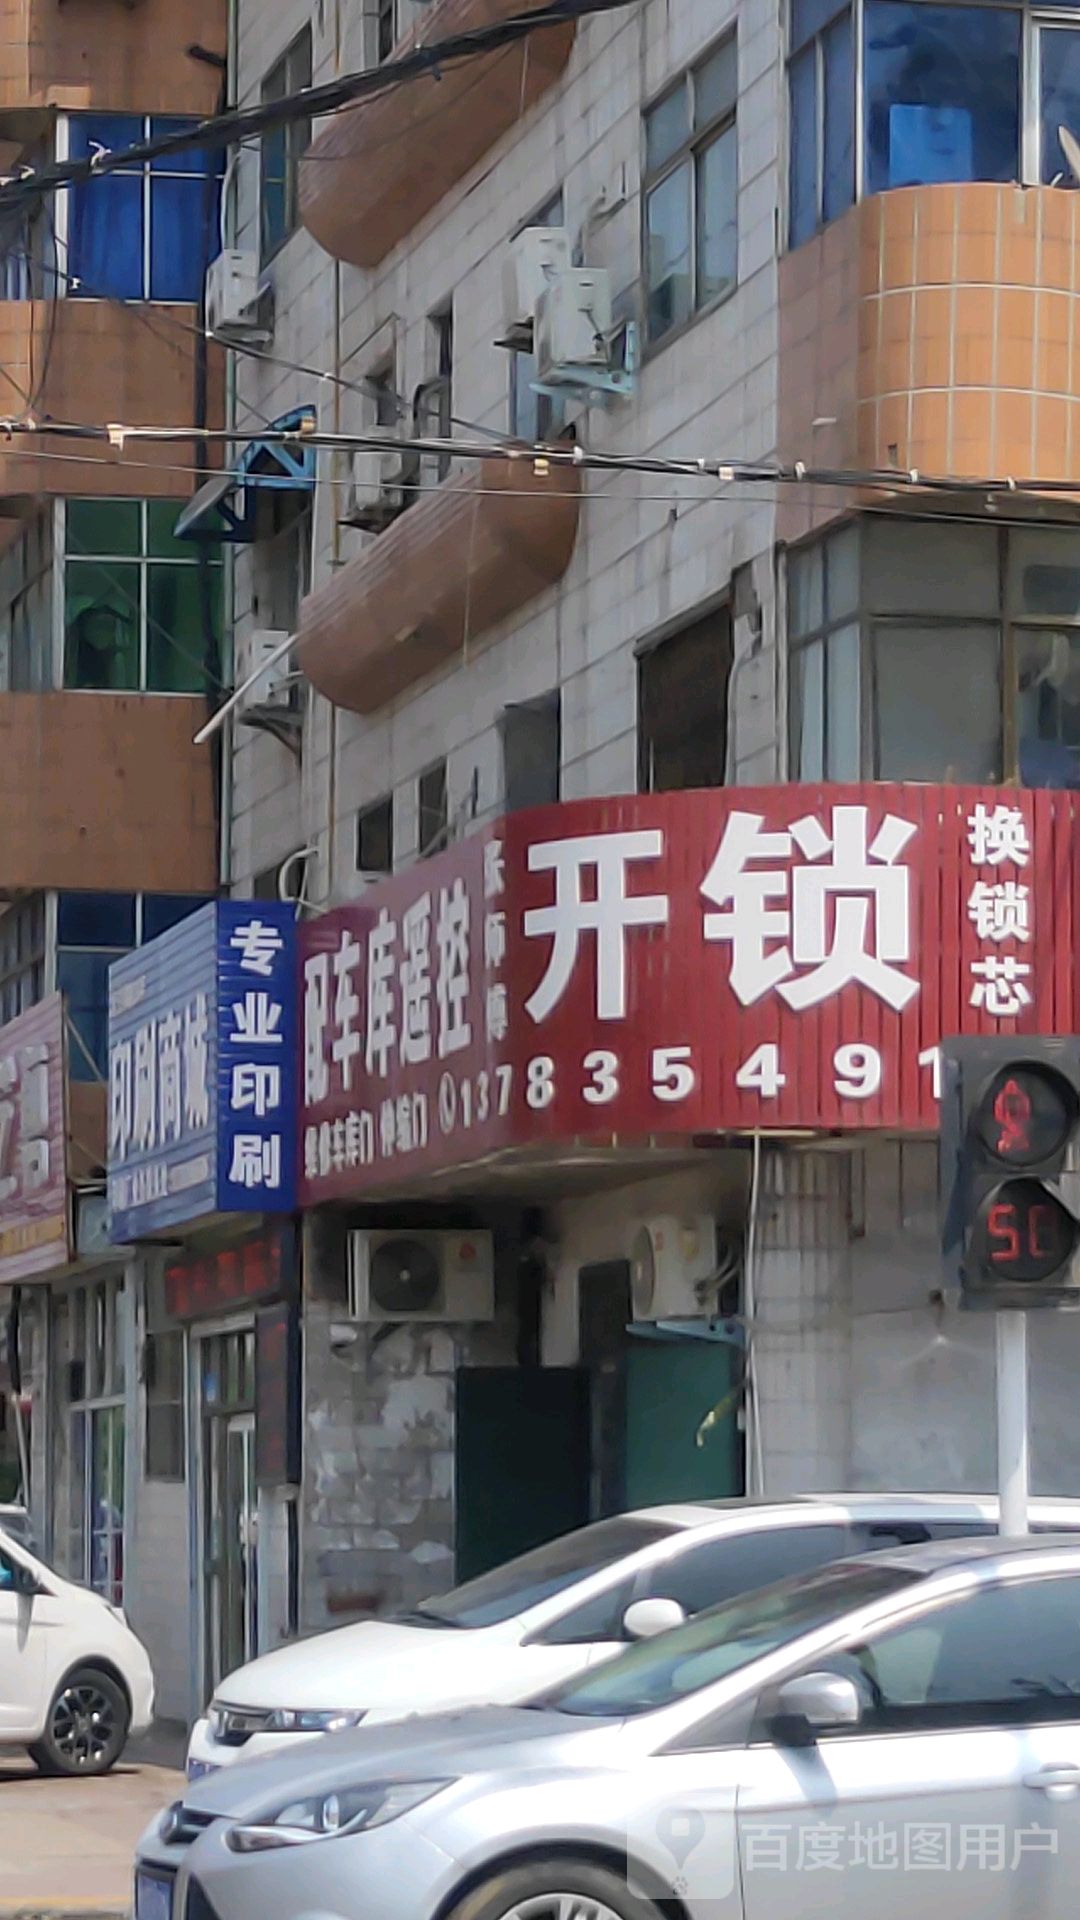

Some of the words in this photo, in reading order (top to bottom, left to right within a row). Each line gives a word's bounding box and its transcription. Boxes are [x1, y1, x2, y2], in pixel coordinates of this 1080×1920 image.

[524, 805, 920, 1023] 开锁
[967, 803, 1031, 1015] 换锁芯
[229, 920, 282, 1189] 专业印刷
